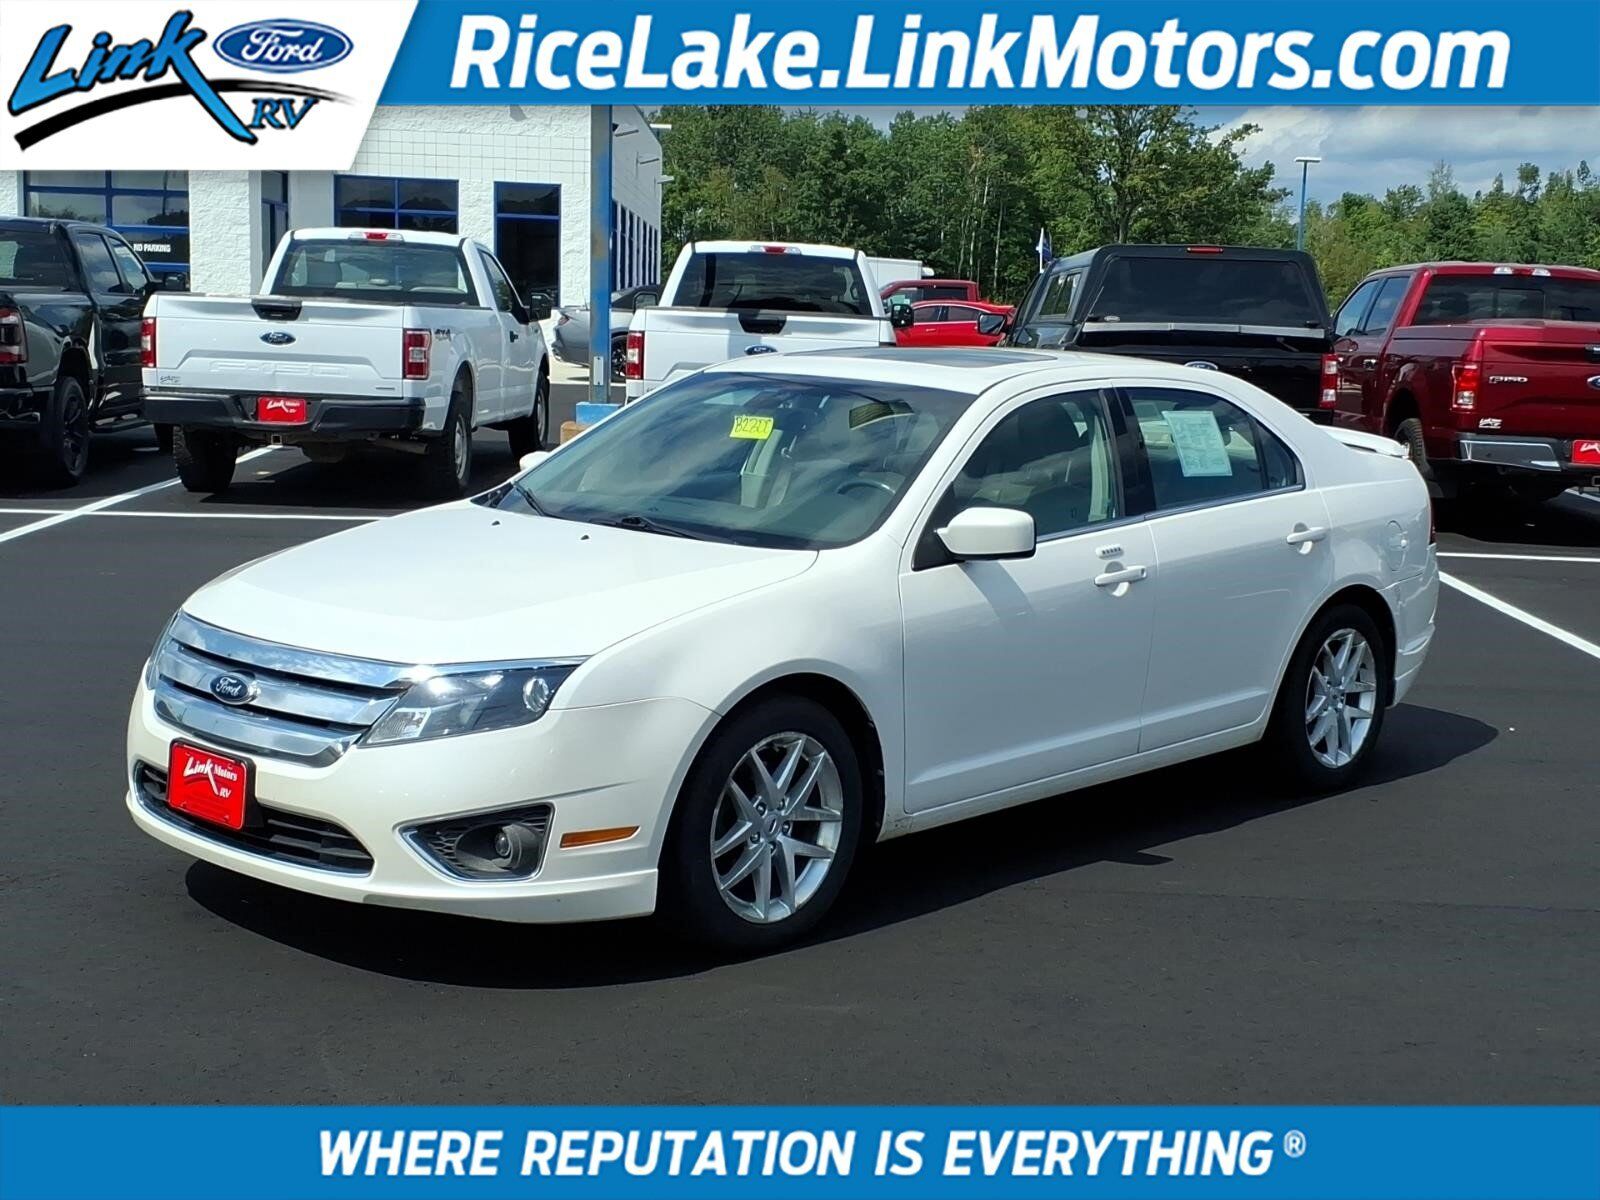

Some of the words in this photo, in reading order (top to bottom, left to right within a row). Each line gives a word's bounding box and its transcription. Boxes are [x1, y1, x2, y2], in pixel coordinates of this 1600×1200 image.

[133, 243, 143, 252] NO
[143, 243, 171, 253] PARKING
[215, 676, 242, 697] Ford
[183, 756, 220, 796] Link
[214, 763, 238, 782] Motors
[219, 787, 232, 799] RV
